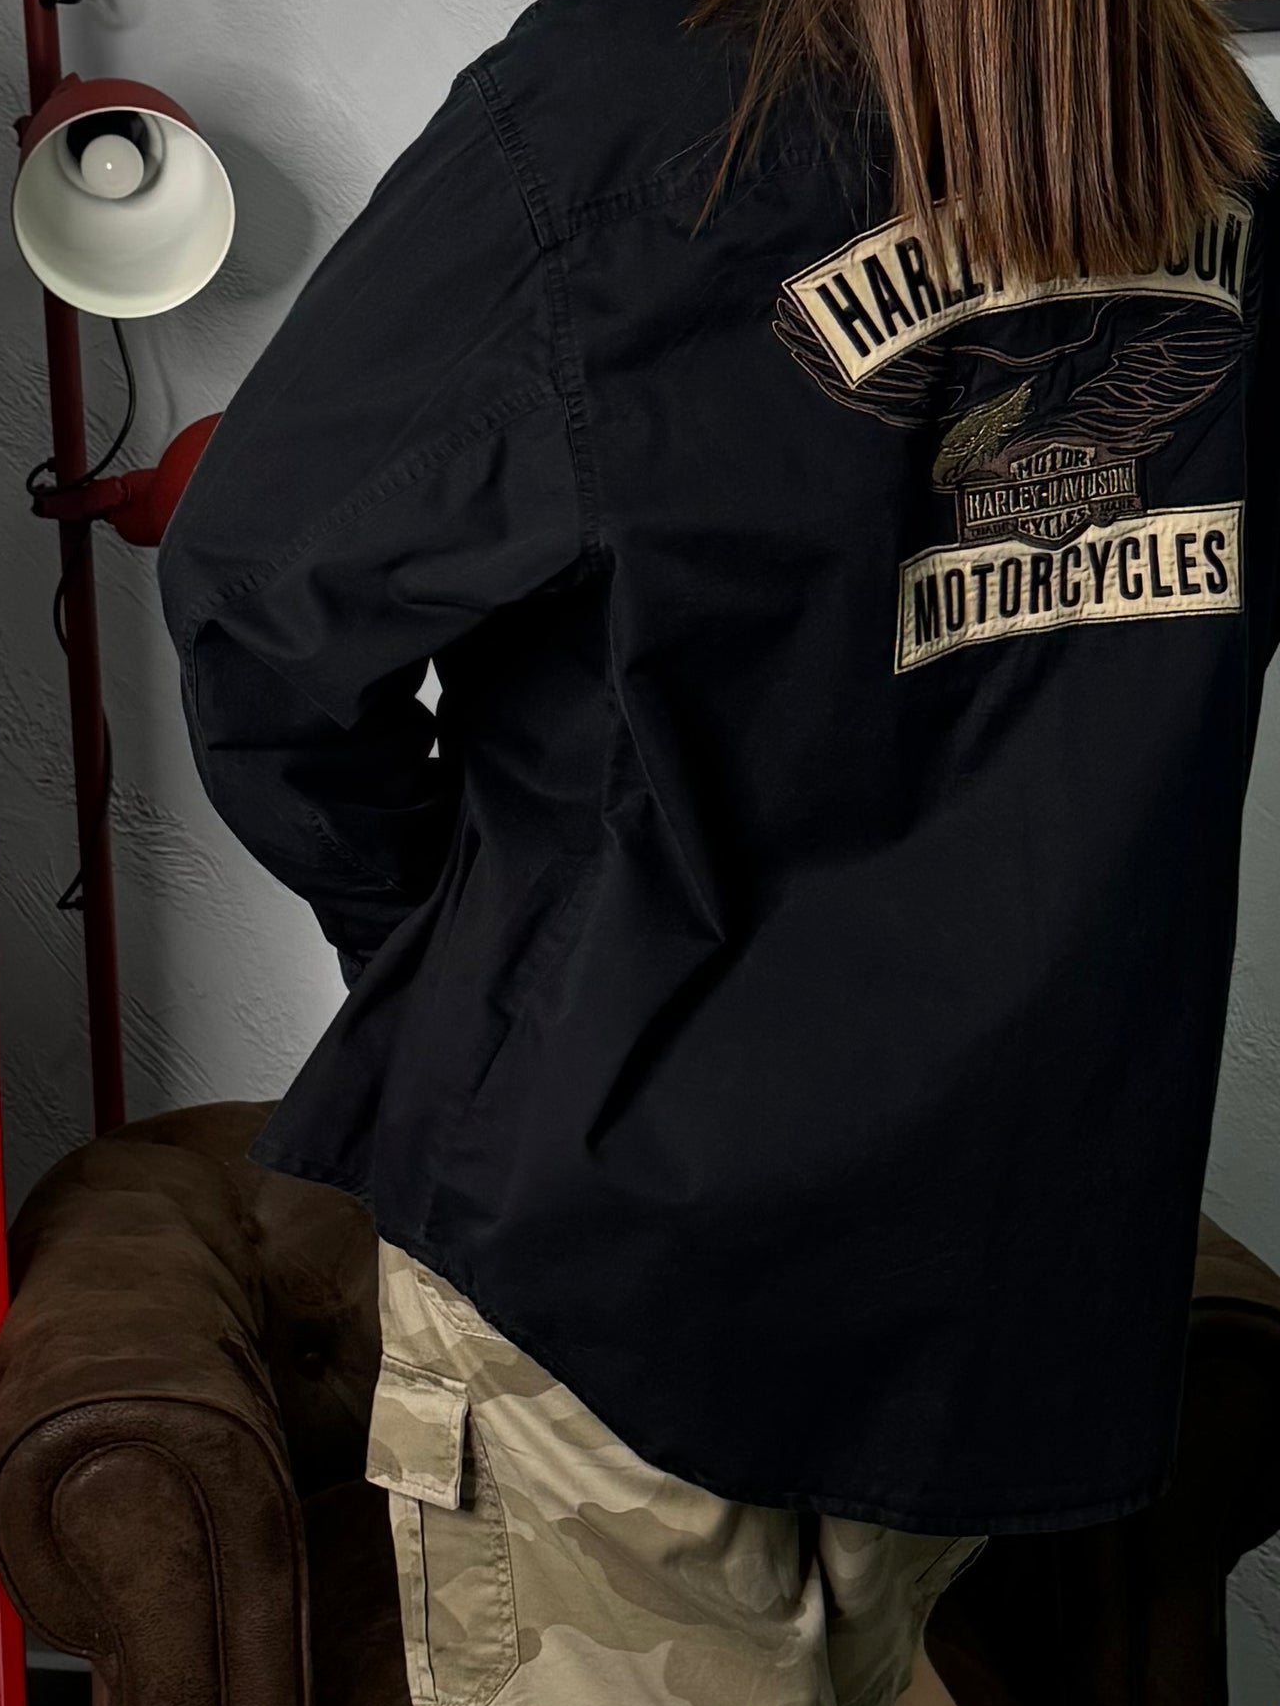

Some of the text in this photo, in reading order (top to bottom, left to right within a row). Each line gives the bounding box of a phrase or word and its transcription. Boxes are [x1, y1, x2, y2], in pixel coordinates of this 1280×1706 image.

[1016, 448, 1089, 479] MOTOR
[969, 466, 1132, 521] HARLEY-DAVIDSON
[913, 528, 1230, 648] MOTORCYCLES
